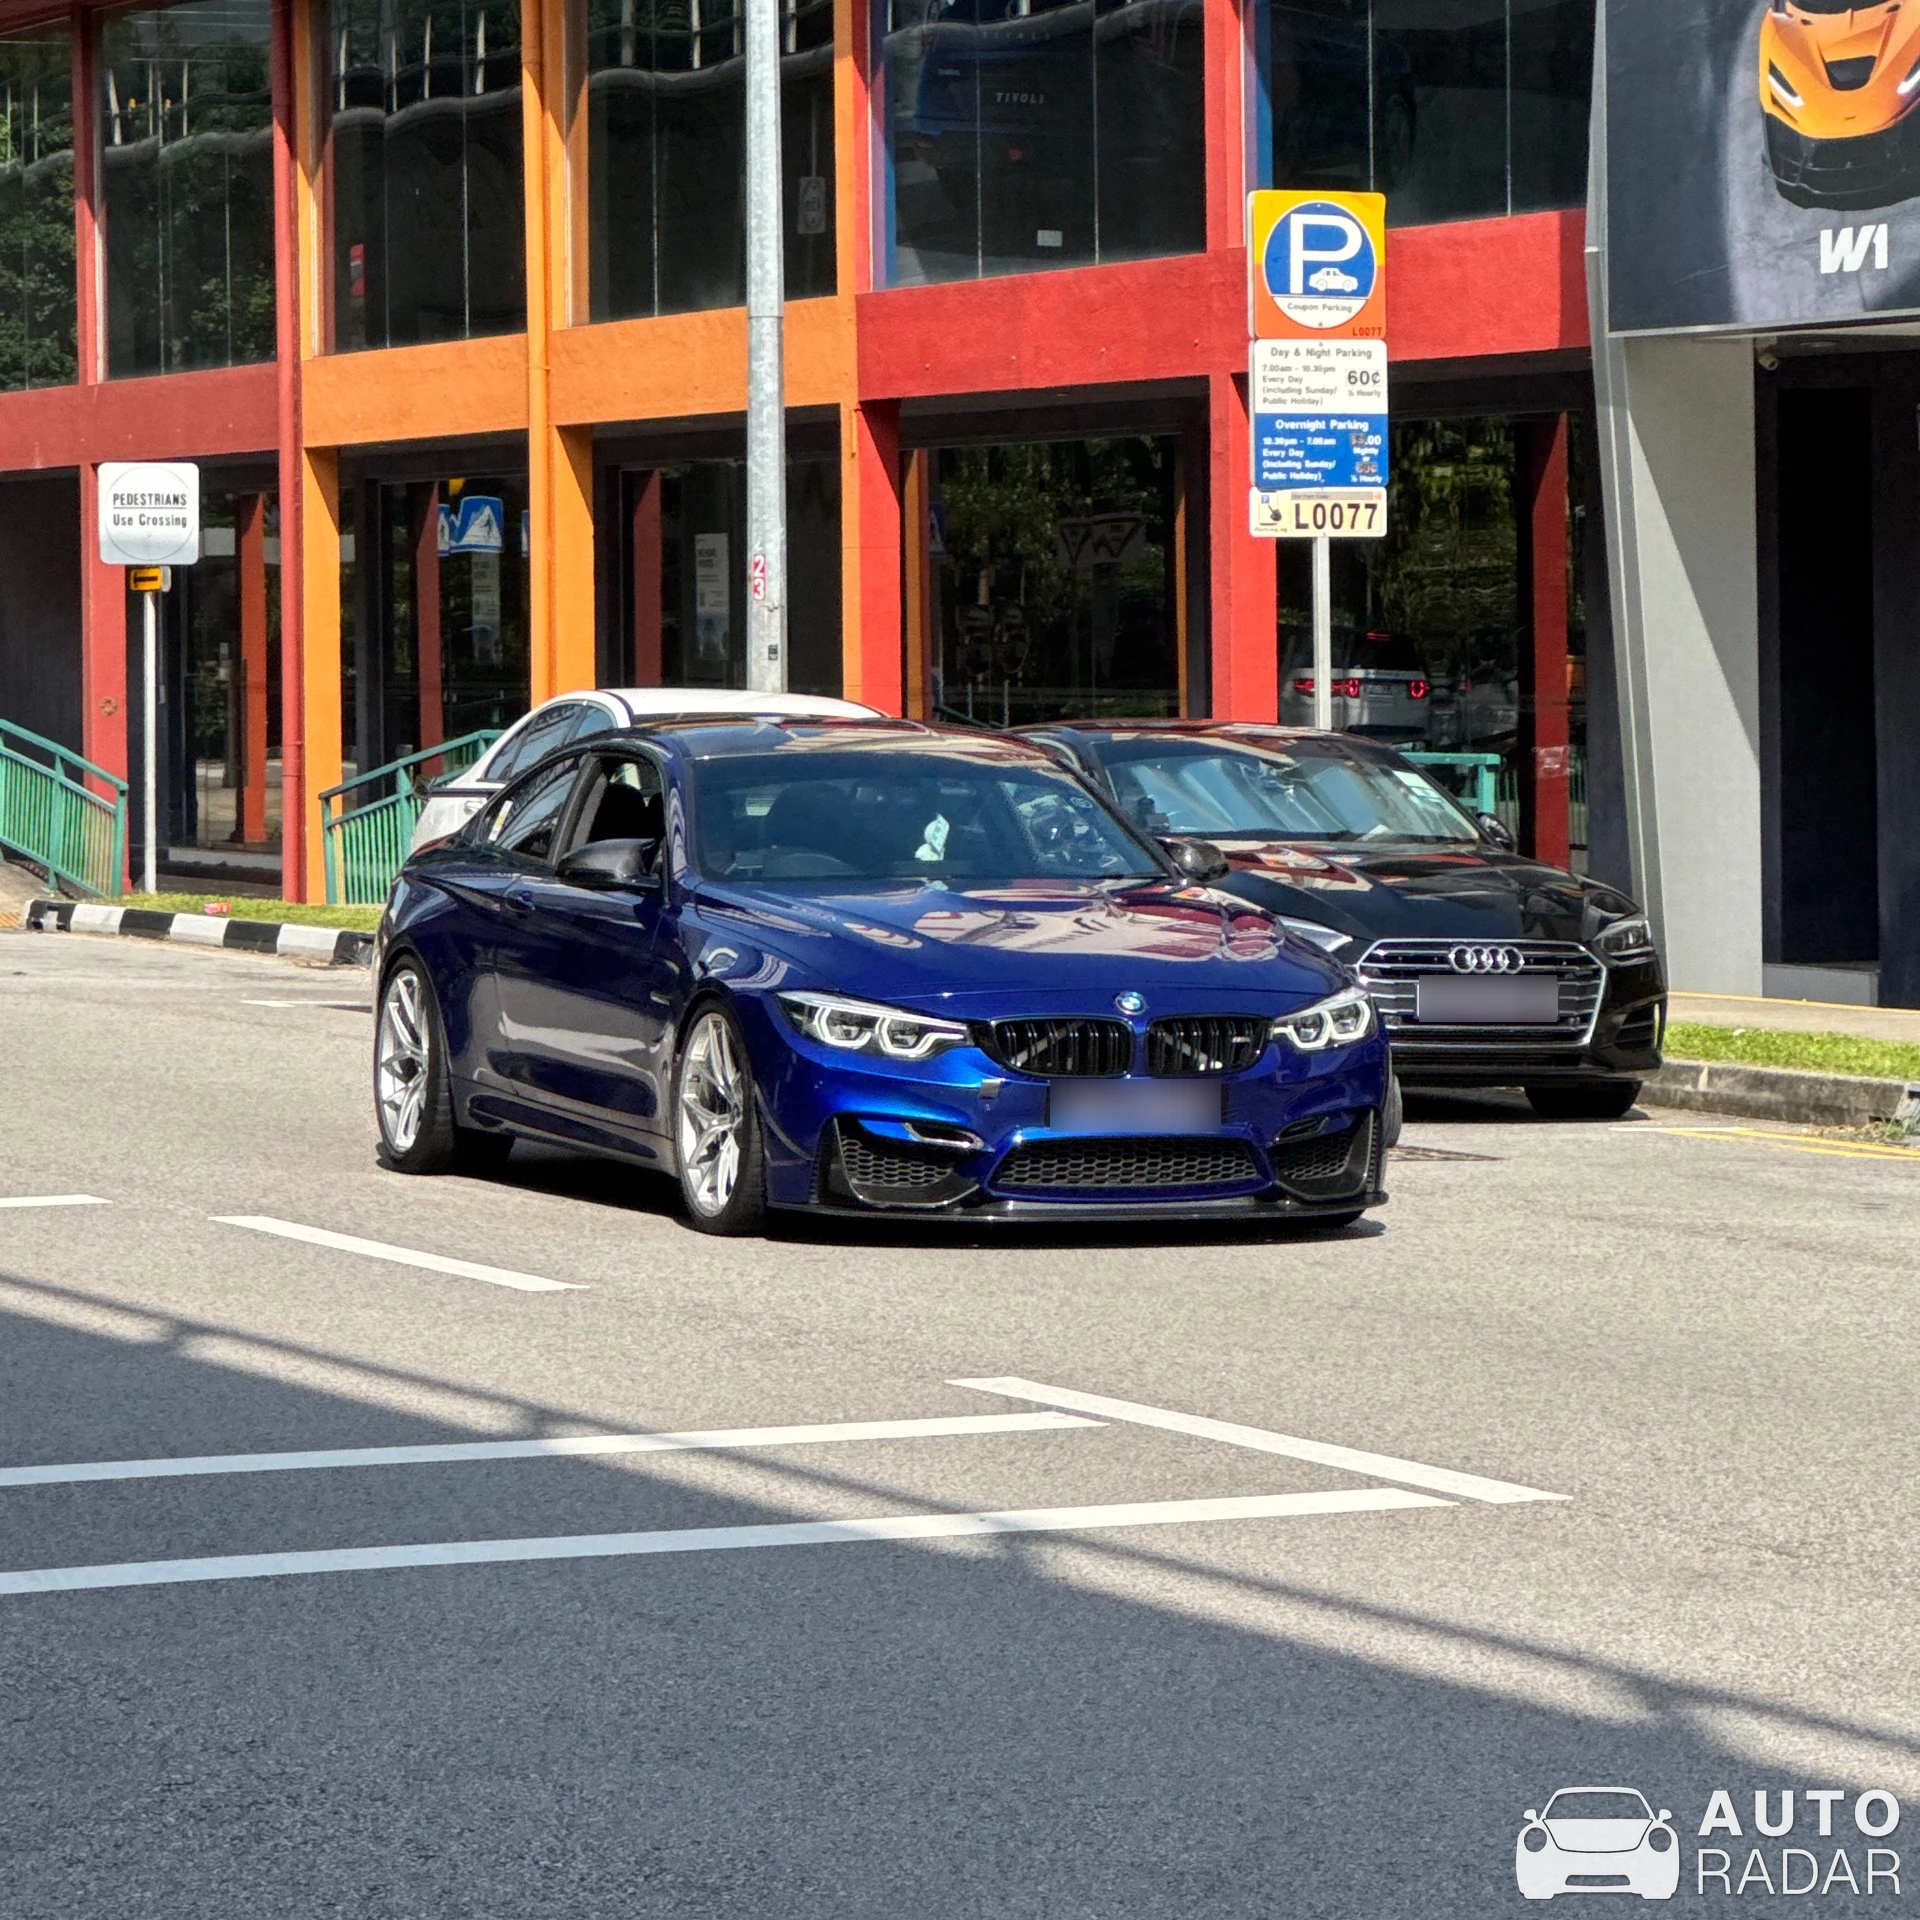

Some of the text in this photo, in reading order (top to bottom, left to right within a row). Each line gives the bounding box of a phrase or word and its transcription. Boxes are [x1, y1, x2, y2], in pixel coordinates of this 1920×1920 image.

[1290, 213, 1363, 294] P
[1820, 223, 1888, 274] W1
[1287, 302, 1353, 314] Coupon Parking
[1352, 327, 1383, 337] L0077
[1270, 347, 1373, 360] Day & Night Parking
[1262, 364, 1292, 373] 7.00am
[1302, 365, 1336, 375] 10.30pm
[1262, 375, 1303, 385] Every Day
[1347, 370, 1381, 386] 60¢
[1262, 385, 1303, 395] (Including
[1356, 389, 1382, 398] Hourly
[1262, 397, 1324, 406] Public Holiday)
[1275, 419, 1370, 432] Overnight Parking
[1262, 437, 1298, 447] 10.30pm
[1262, 448, 1305, 459] Every Day
[1262, 460, 1303, 470] (Including
[1262, 471, 1288, 480] Public
[113, 493, 187, 506] PEDESTRIANS
[113, 513, 187, 528] Use Crossing
[1295, 503, 1378, 530] L0077
